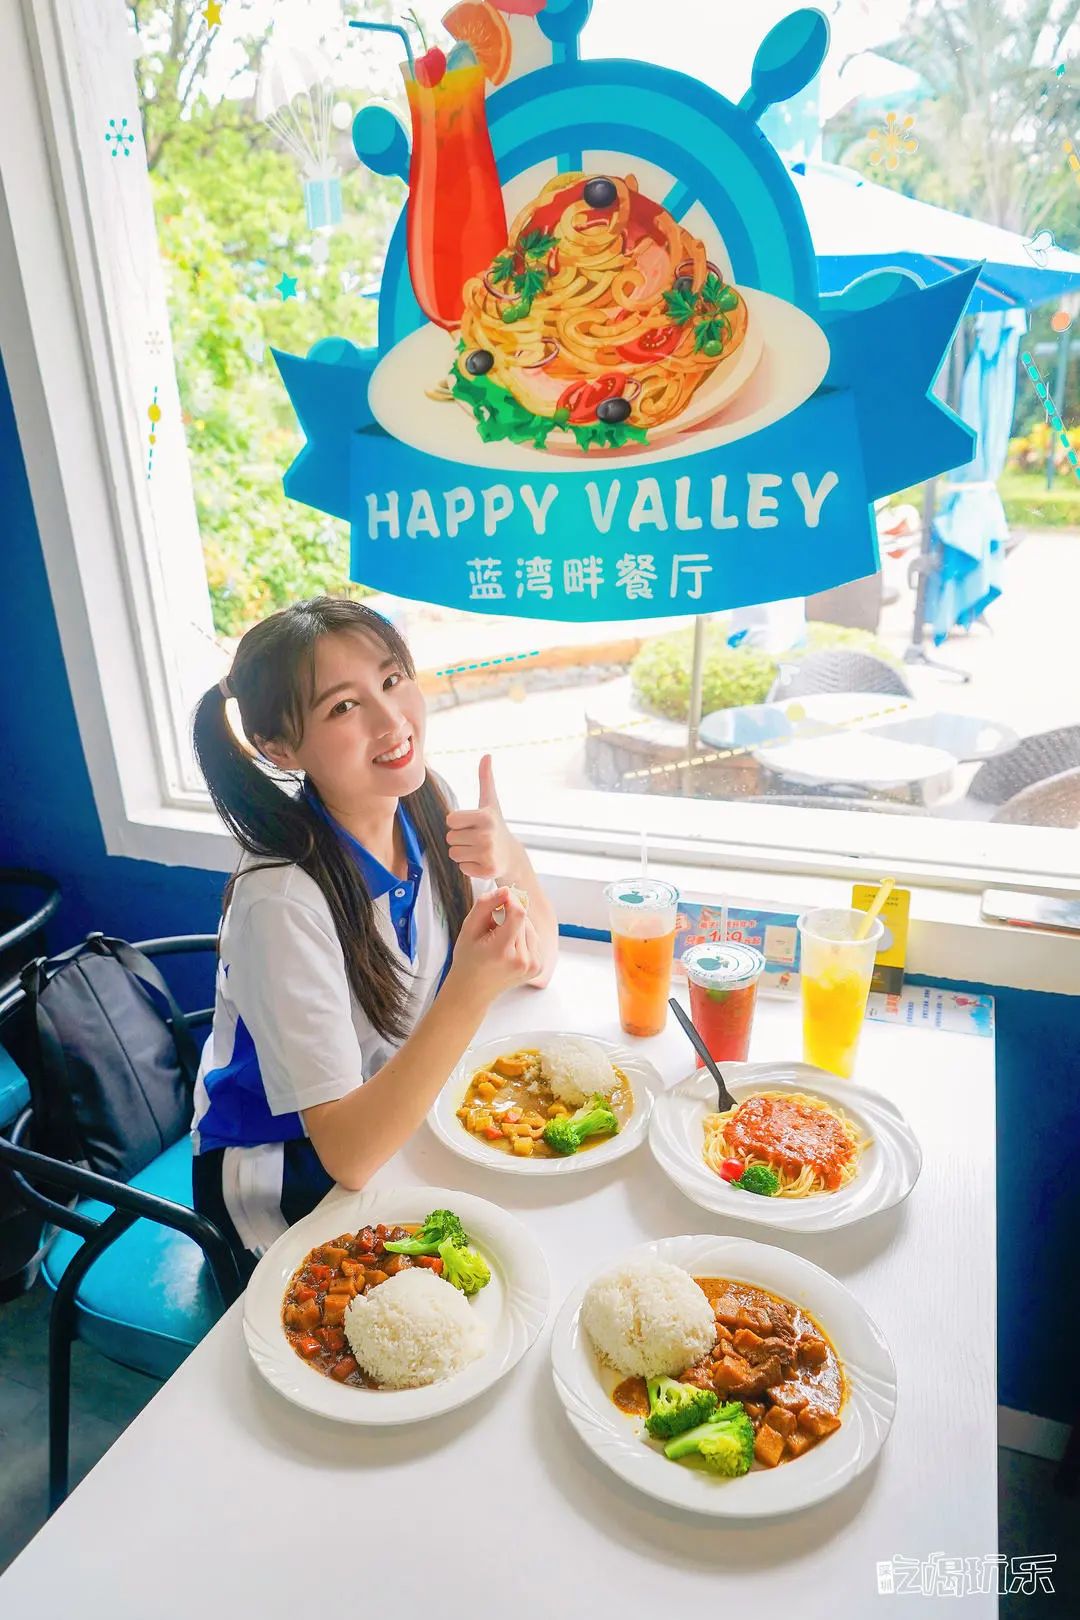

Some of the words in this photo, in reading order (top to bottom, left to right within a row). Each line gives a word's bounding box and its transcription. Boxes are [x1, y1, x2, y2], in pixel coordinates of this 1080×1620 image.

[366, 483, 559, 539] HAPPY
[586, 472, 839, 534] VALLEY
[467, 553, 713, 600] 蓝湾畔餐厅
